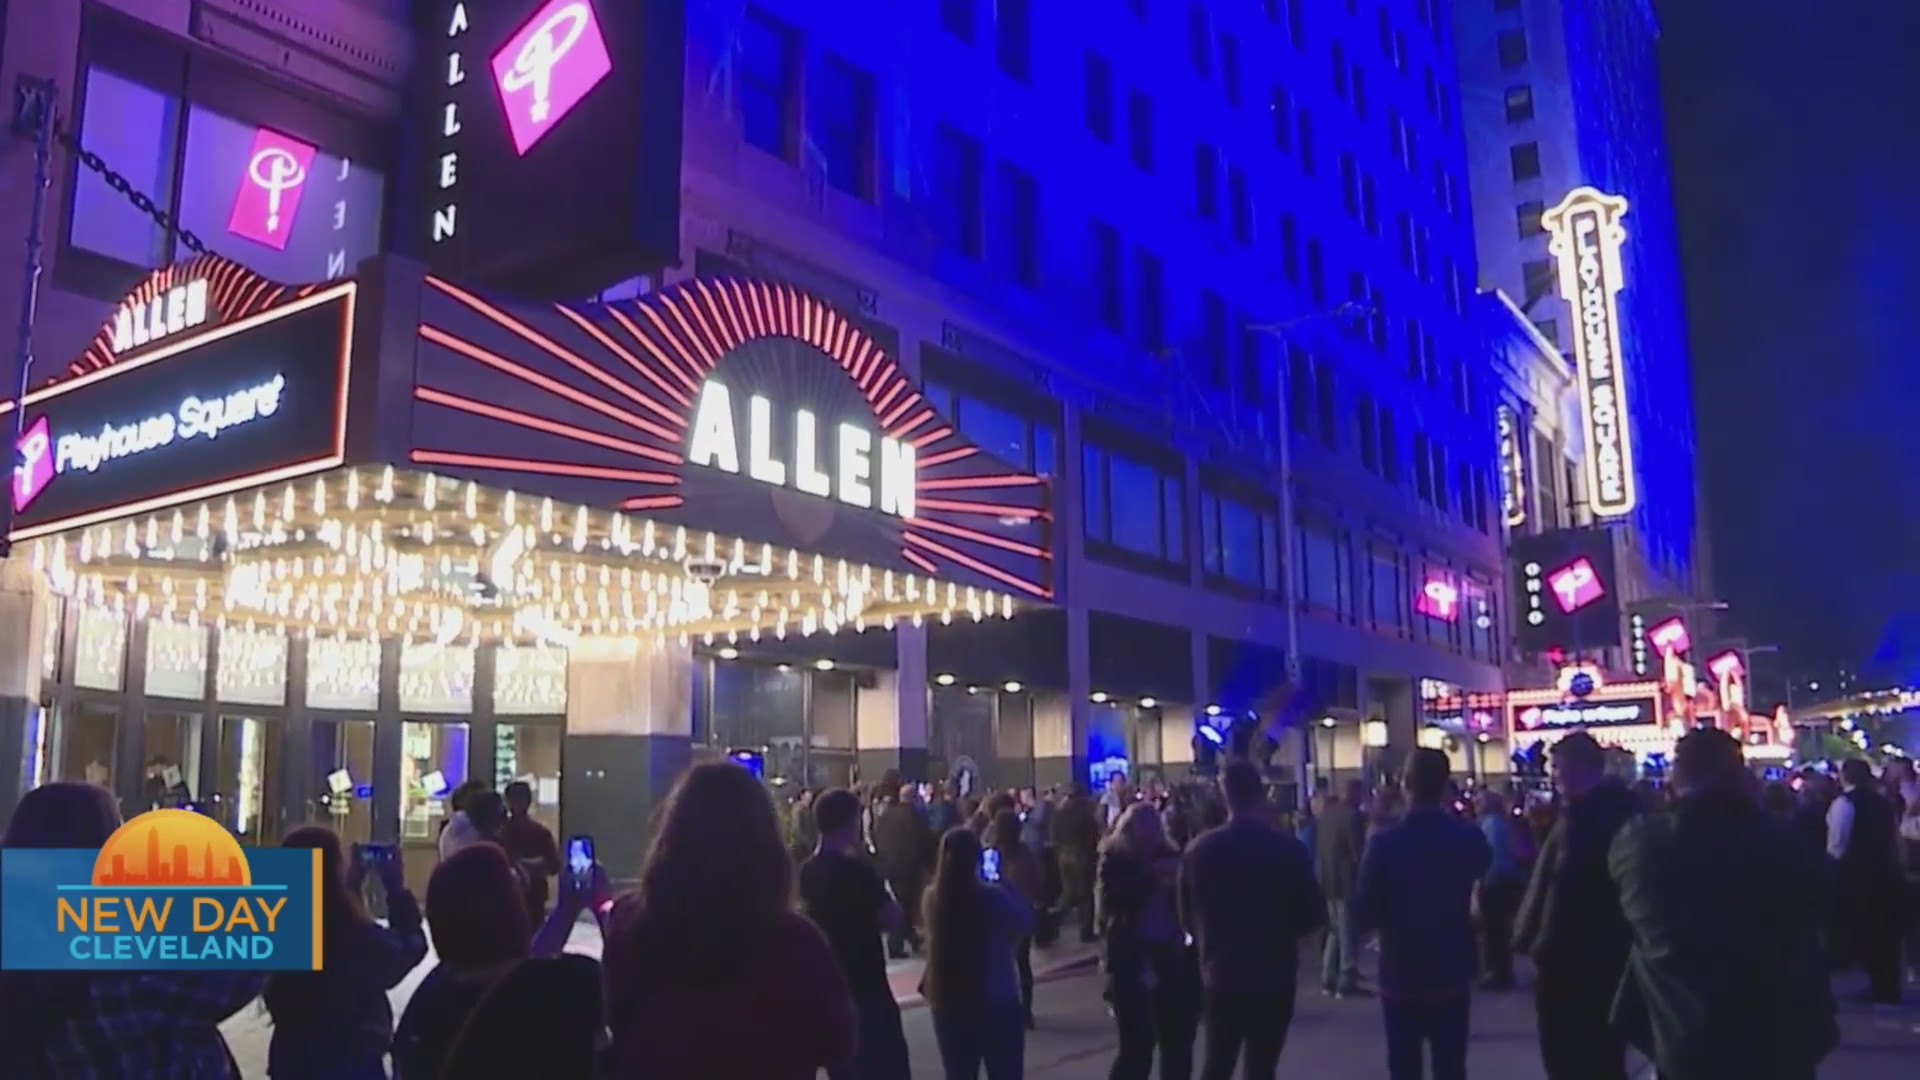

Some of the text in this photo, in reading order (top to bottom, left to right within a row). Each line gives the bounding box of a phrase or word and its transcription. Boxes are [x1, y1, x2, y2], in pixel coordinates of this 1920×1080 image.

[433, 2, 468, 242] ALLEN
[112, 277, 208, 353] ALLEN
[55, 412, 176, 474] Playhouse
[689, 379, 916, 519] ALLEN
[1524, 562, 1544, 625] OHIO
